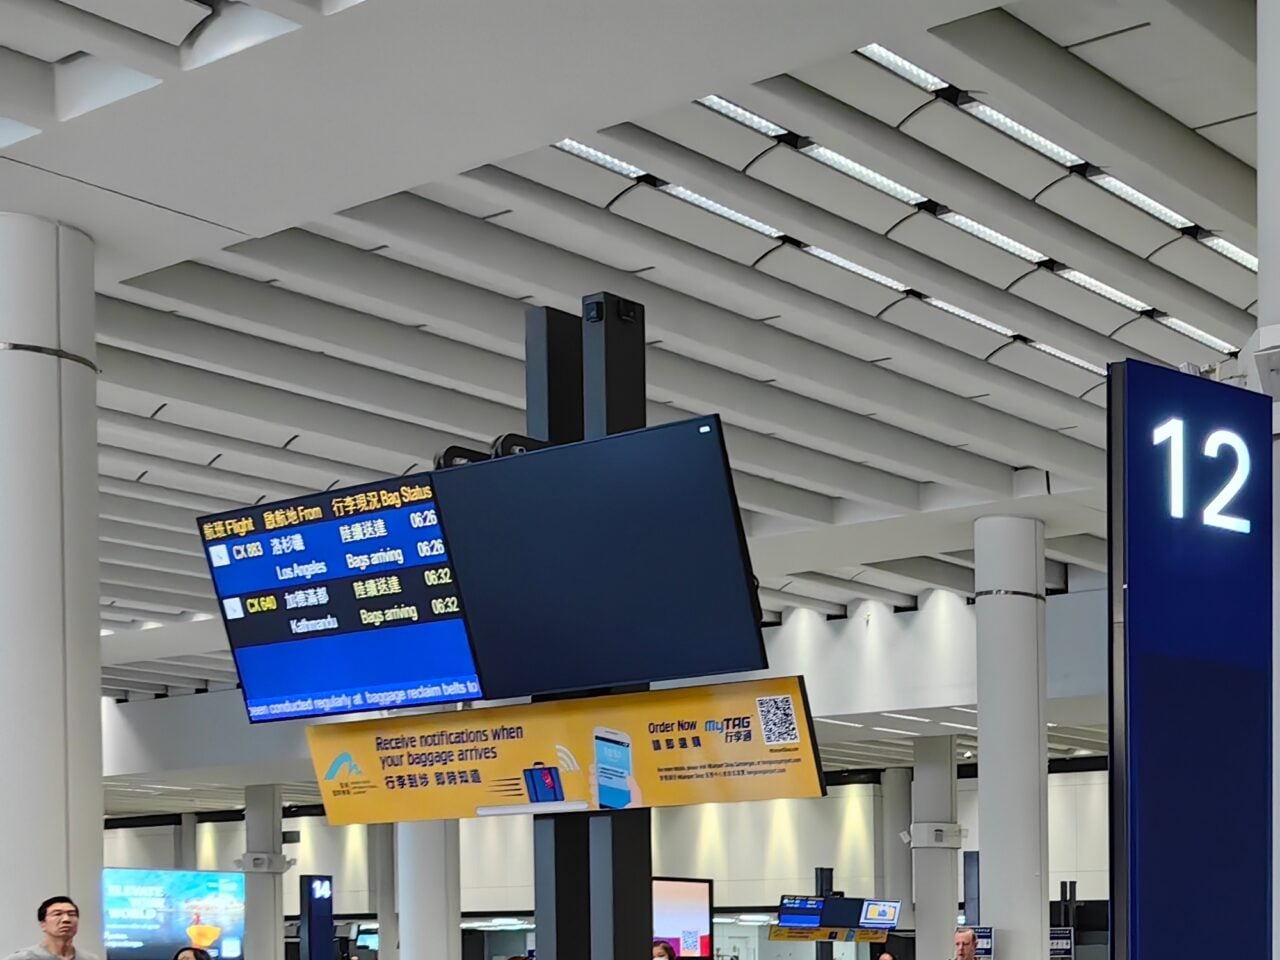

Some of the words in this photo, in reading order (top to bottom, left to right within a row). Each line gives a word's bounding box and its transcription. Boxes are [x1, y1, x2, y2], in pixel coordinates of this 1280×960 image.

[1152, 417, 1251, 534] 12
[331, 492, 382, 515] 行李現況
[380, 489, 401, 509] Bag
[400, 483, 432, 501] Status
[298, 504, 322, 521] From
[409, 510, 438, 528] 06:26
[225, 516, 255, 536] Flight
[232, 545, 247, 558] CX
[346, 552, 370, 569] Bags
[369, 545, 404, 566] arriving
[417, 539, 445, 556] 06:26
[276, 565, 293, 579] Los
[292, 559, 328, 579] Angeles
[424, 568, 452, 585] 06:32
[246, 599, 260, 612] CX
[359, 607, 384, 625] Bags
[383, 602, 419, 623] arriving
[431, 596, 459, 613] 06:32
[290, 614, 339, 633] Kathmandu
[268, 699, 314, 715] conducted
[312, 695, 353, 711] regularly
[351, 695, 363, 704] at
[365, 688, 407, 705] baggage
[405, 683, 442, 698] reclaim
[441, 680, 467, 695] belts
[648, 721, 675, 734] Order
[678, 720, 697, 732] Now
[724, 729, 752, 743] 行李通
[376, 735, 416, 751] Receive
[420, 728, 488, 748] notifications
[492, 726, 523, 741] when
[380, 752, 403, 770] your
[408, 749, 454, 767] baggage
[458, 745, 497, 760] arrives
[385, 773, 429, 790] 行李到埗
[435, 769, 482, 786] 即時知道
[312, 879, 332, 898] 14
